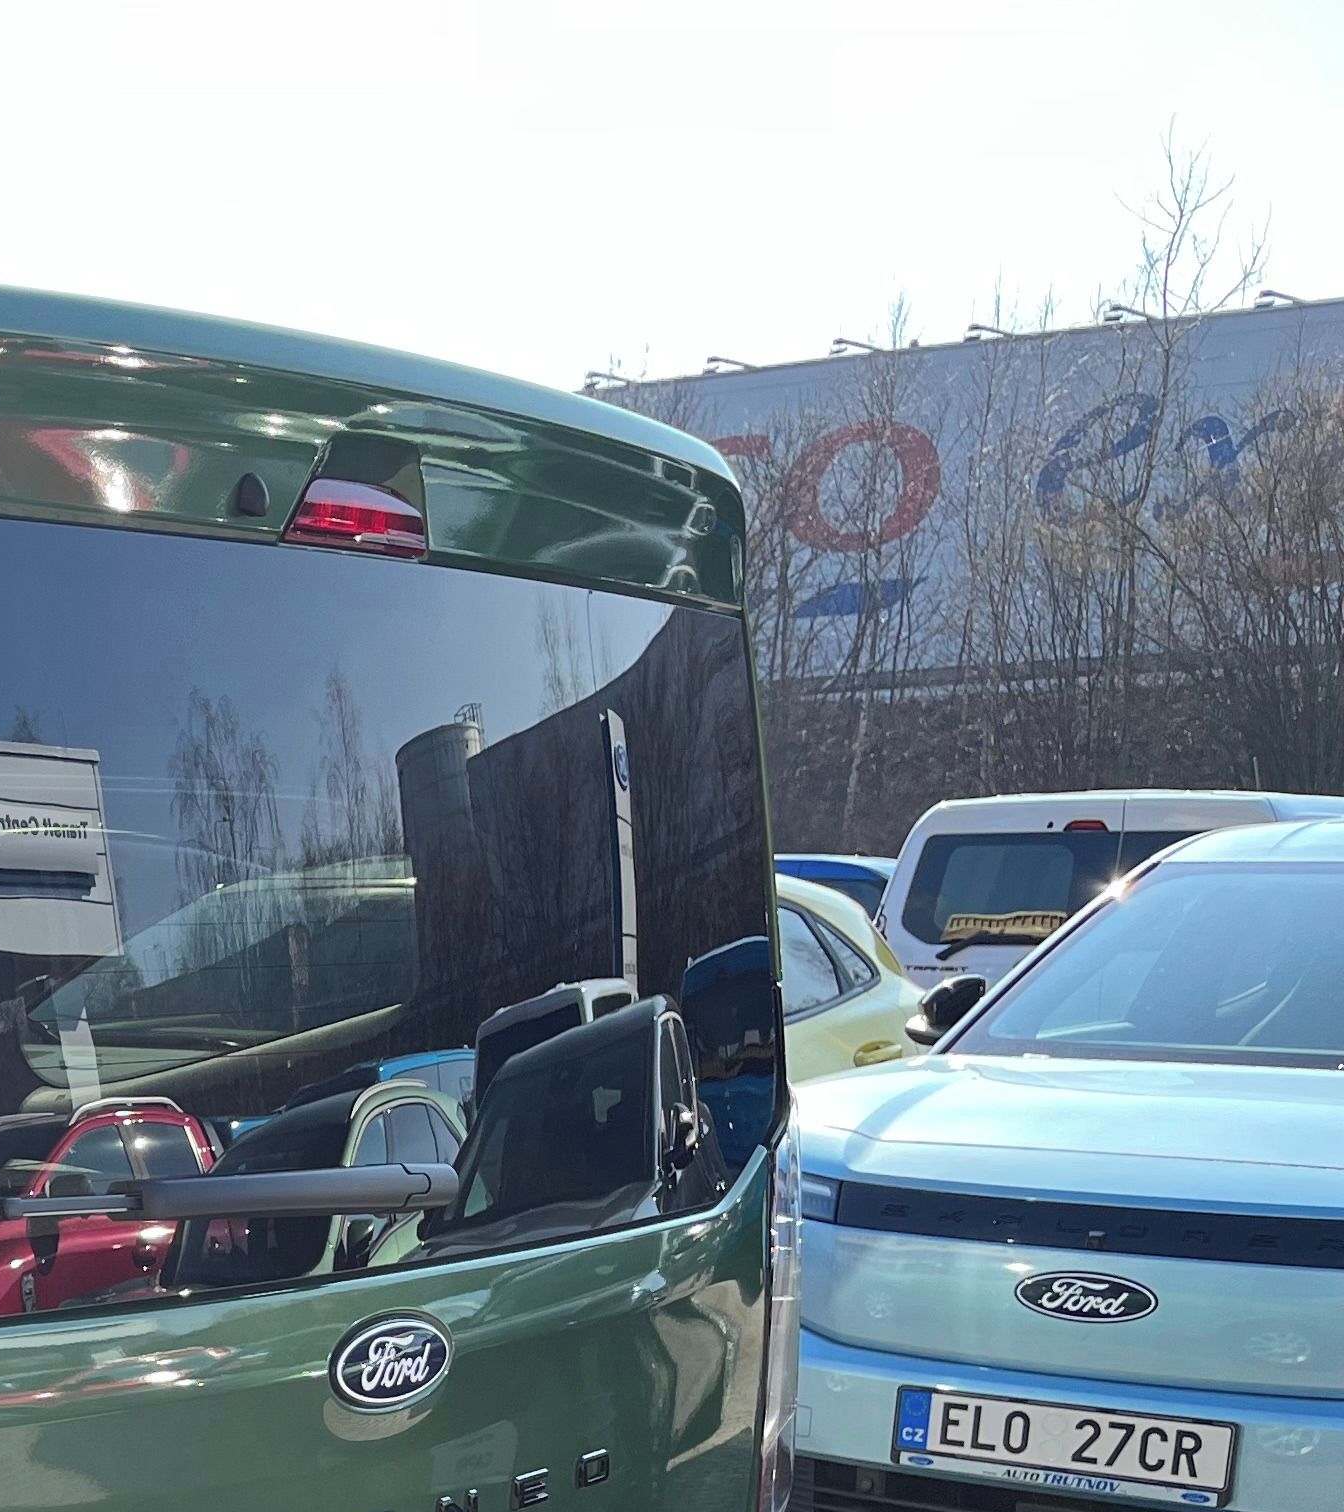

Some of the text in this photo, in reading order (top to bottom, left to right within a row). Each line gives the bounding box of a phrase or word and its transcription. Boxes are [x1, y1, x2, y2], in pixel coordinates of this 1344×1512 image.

[1038, 1277, 1128, 1317] Ford
[360, 1333, 432, 1393] Ford
[902, 1426, 924, 1443] CZ
[1071, 1418, 1203, 1479] 27CR
